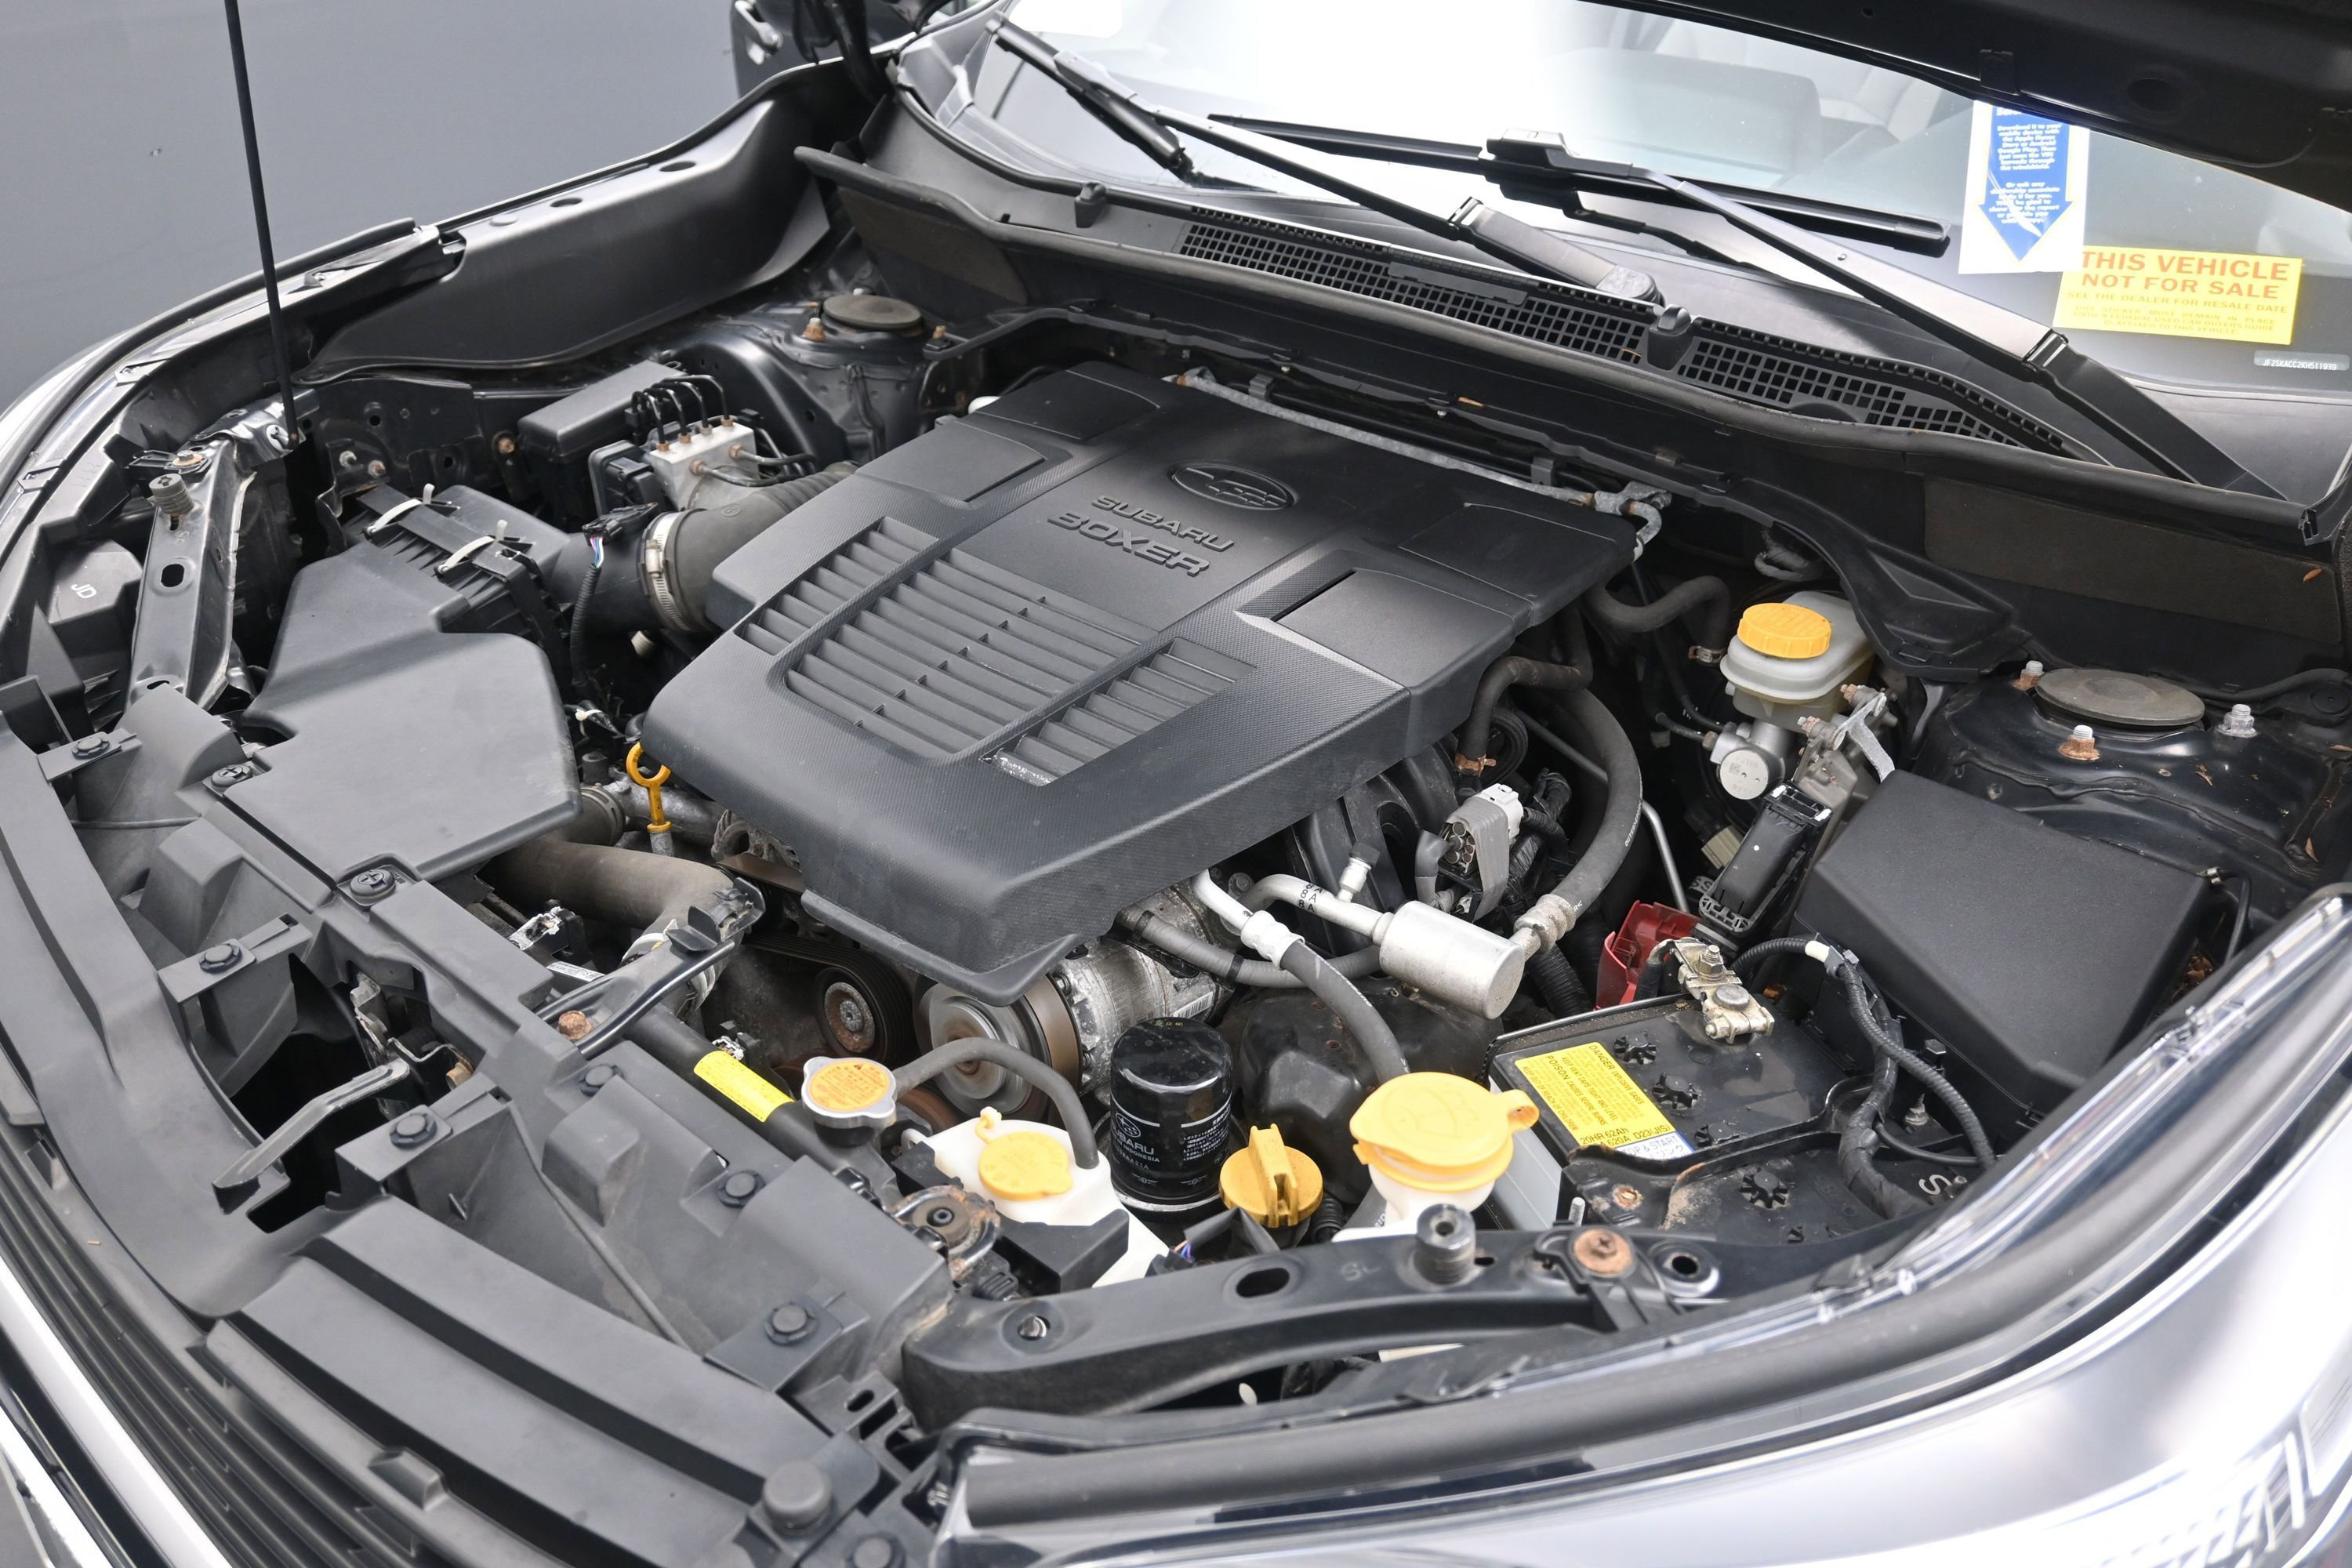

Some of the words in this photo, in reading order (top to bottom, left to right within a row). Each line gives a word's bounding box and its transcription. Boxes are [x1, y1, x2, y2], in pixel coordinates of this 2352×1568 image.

[2082, 251, 2146, 271] THIS
[2157, 254, 2290, 281] VEHICLE
[2082, 274, 2136, 289] NOT
[2143, 277, 2198, 293] FOR
[2209, 281, 2280, 299] SALE
[2095, 292, 2116, 301] THE
[2121, 295, 2170, 304] DEALER
[2174, 298, 2199, 307] FOR
[2204, 300, 2252, 311] RESALE
[2256, 304, 2288, 314] DATE
[2263, 358, 2337, 371] JF2SKACC2KH511939
[1091, 494, 1235, 553] SUBARU
[1047, 511, 1210, 577] BOXER
[71, 583, 97, 599] JD
[1545, 1055, 1569, 1080] POISON
[1589, 1045, 1615, 1069] DANGER
[1613, 1070, 1633, 1091] EXPLOSIVE
[1630, 1091, 1644, 1105] GASES
[1580, 1132, 1606, 1145] 20HR
[1606, 1127, 1630, 1139] 62Ah
[1606, 1134, 1632, 1147] 620A
[1634, 1123, 1671, 1140] D23(JIS)
[1649, 1135, 1679, 1150] START
[1123, 1144, 1160, 1163] INDONESIA
